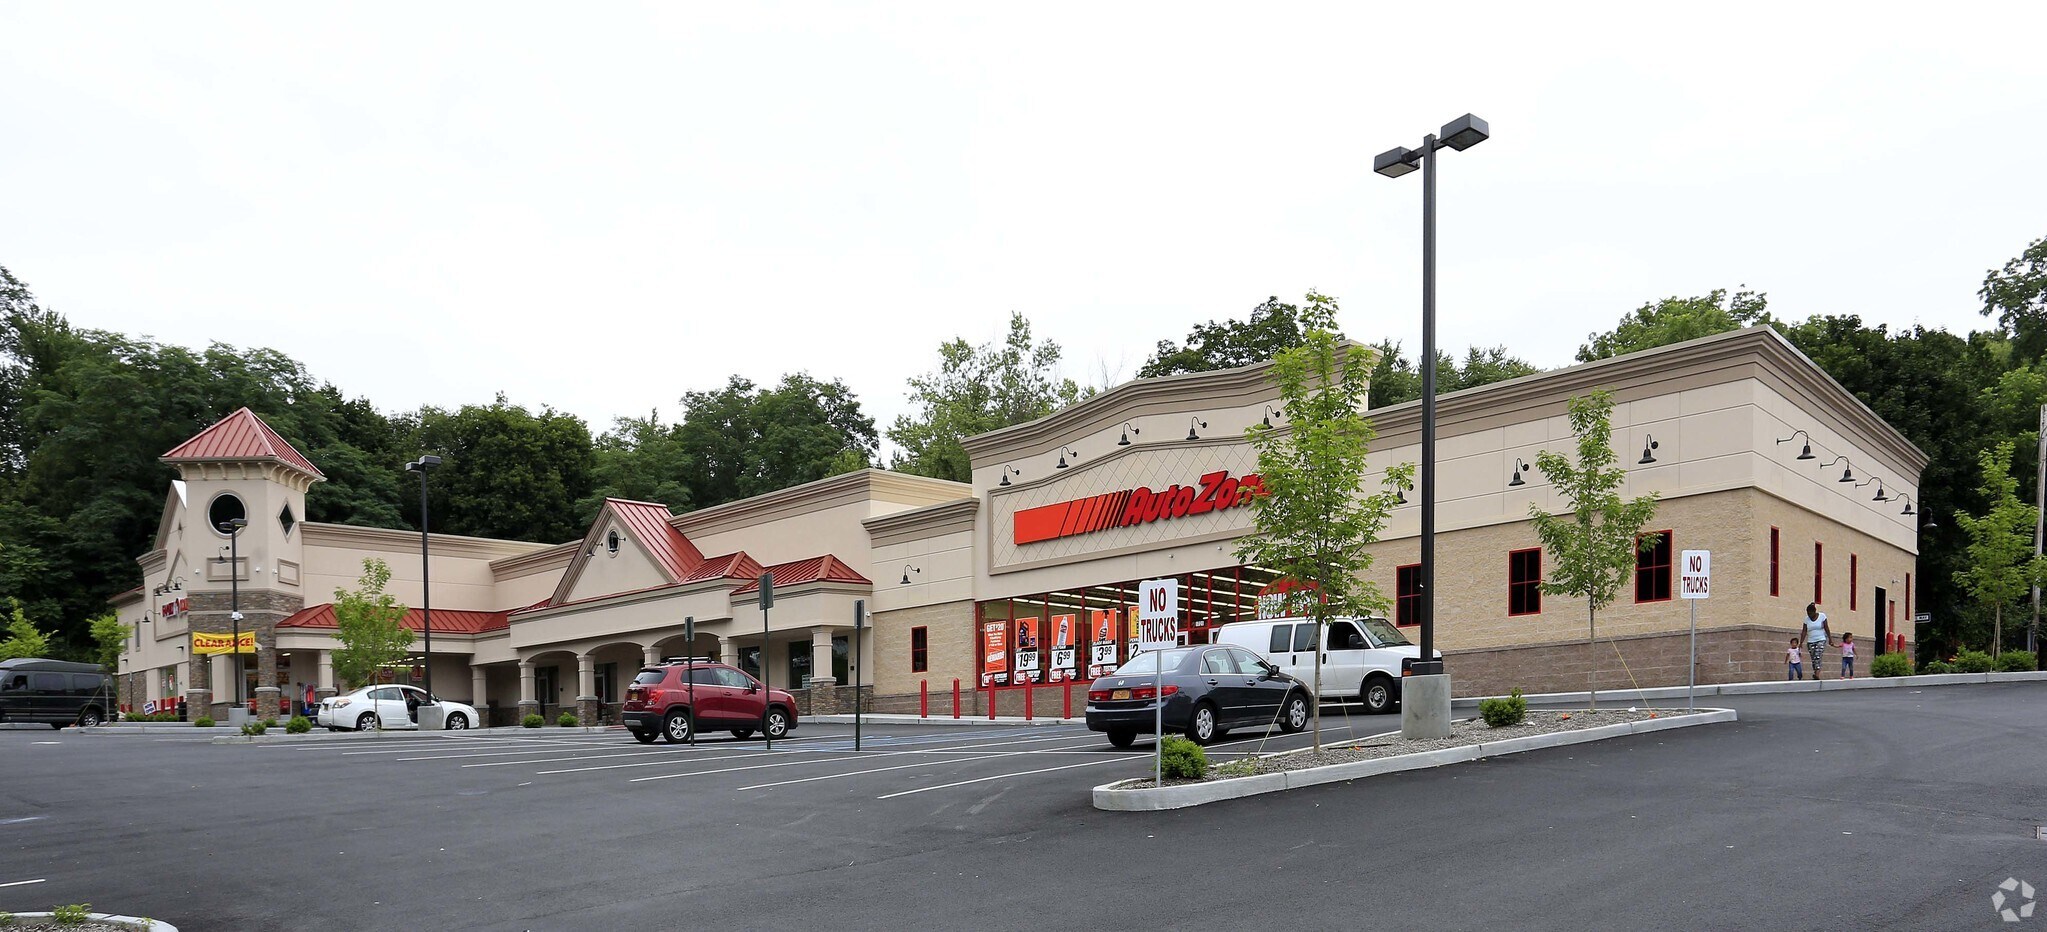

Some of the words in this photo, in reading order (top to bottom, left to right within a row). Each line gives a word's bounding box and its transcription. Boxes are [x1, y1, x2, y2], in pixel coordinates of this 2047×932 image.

[1689, 555, 1702, 573] NO
[1682, 576, 1708, 594] TRUCKS
[1149, 587, 1167, 613] NO
[1140, 616, 1176, 643] TRUCKS
